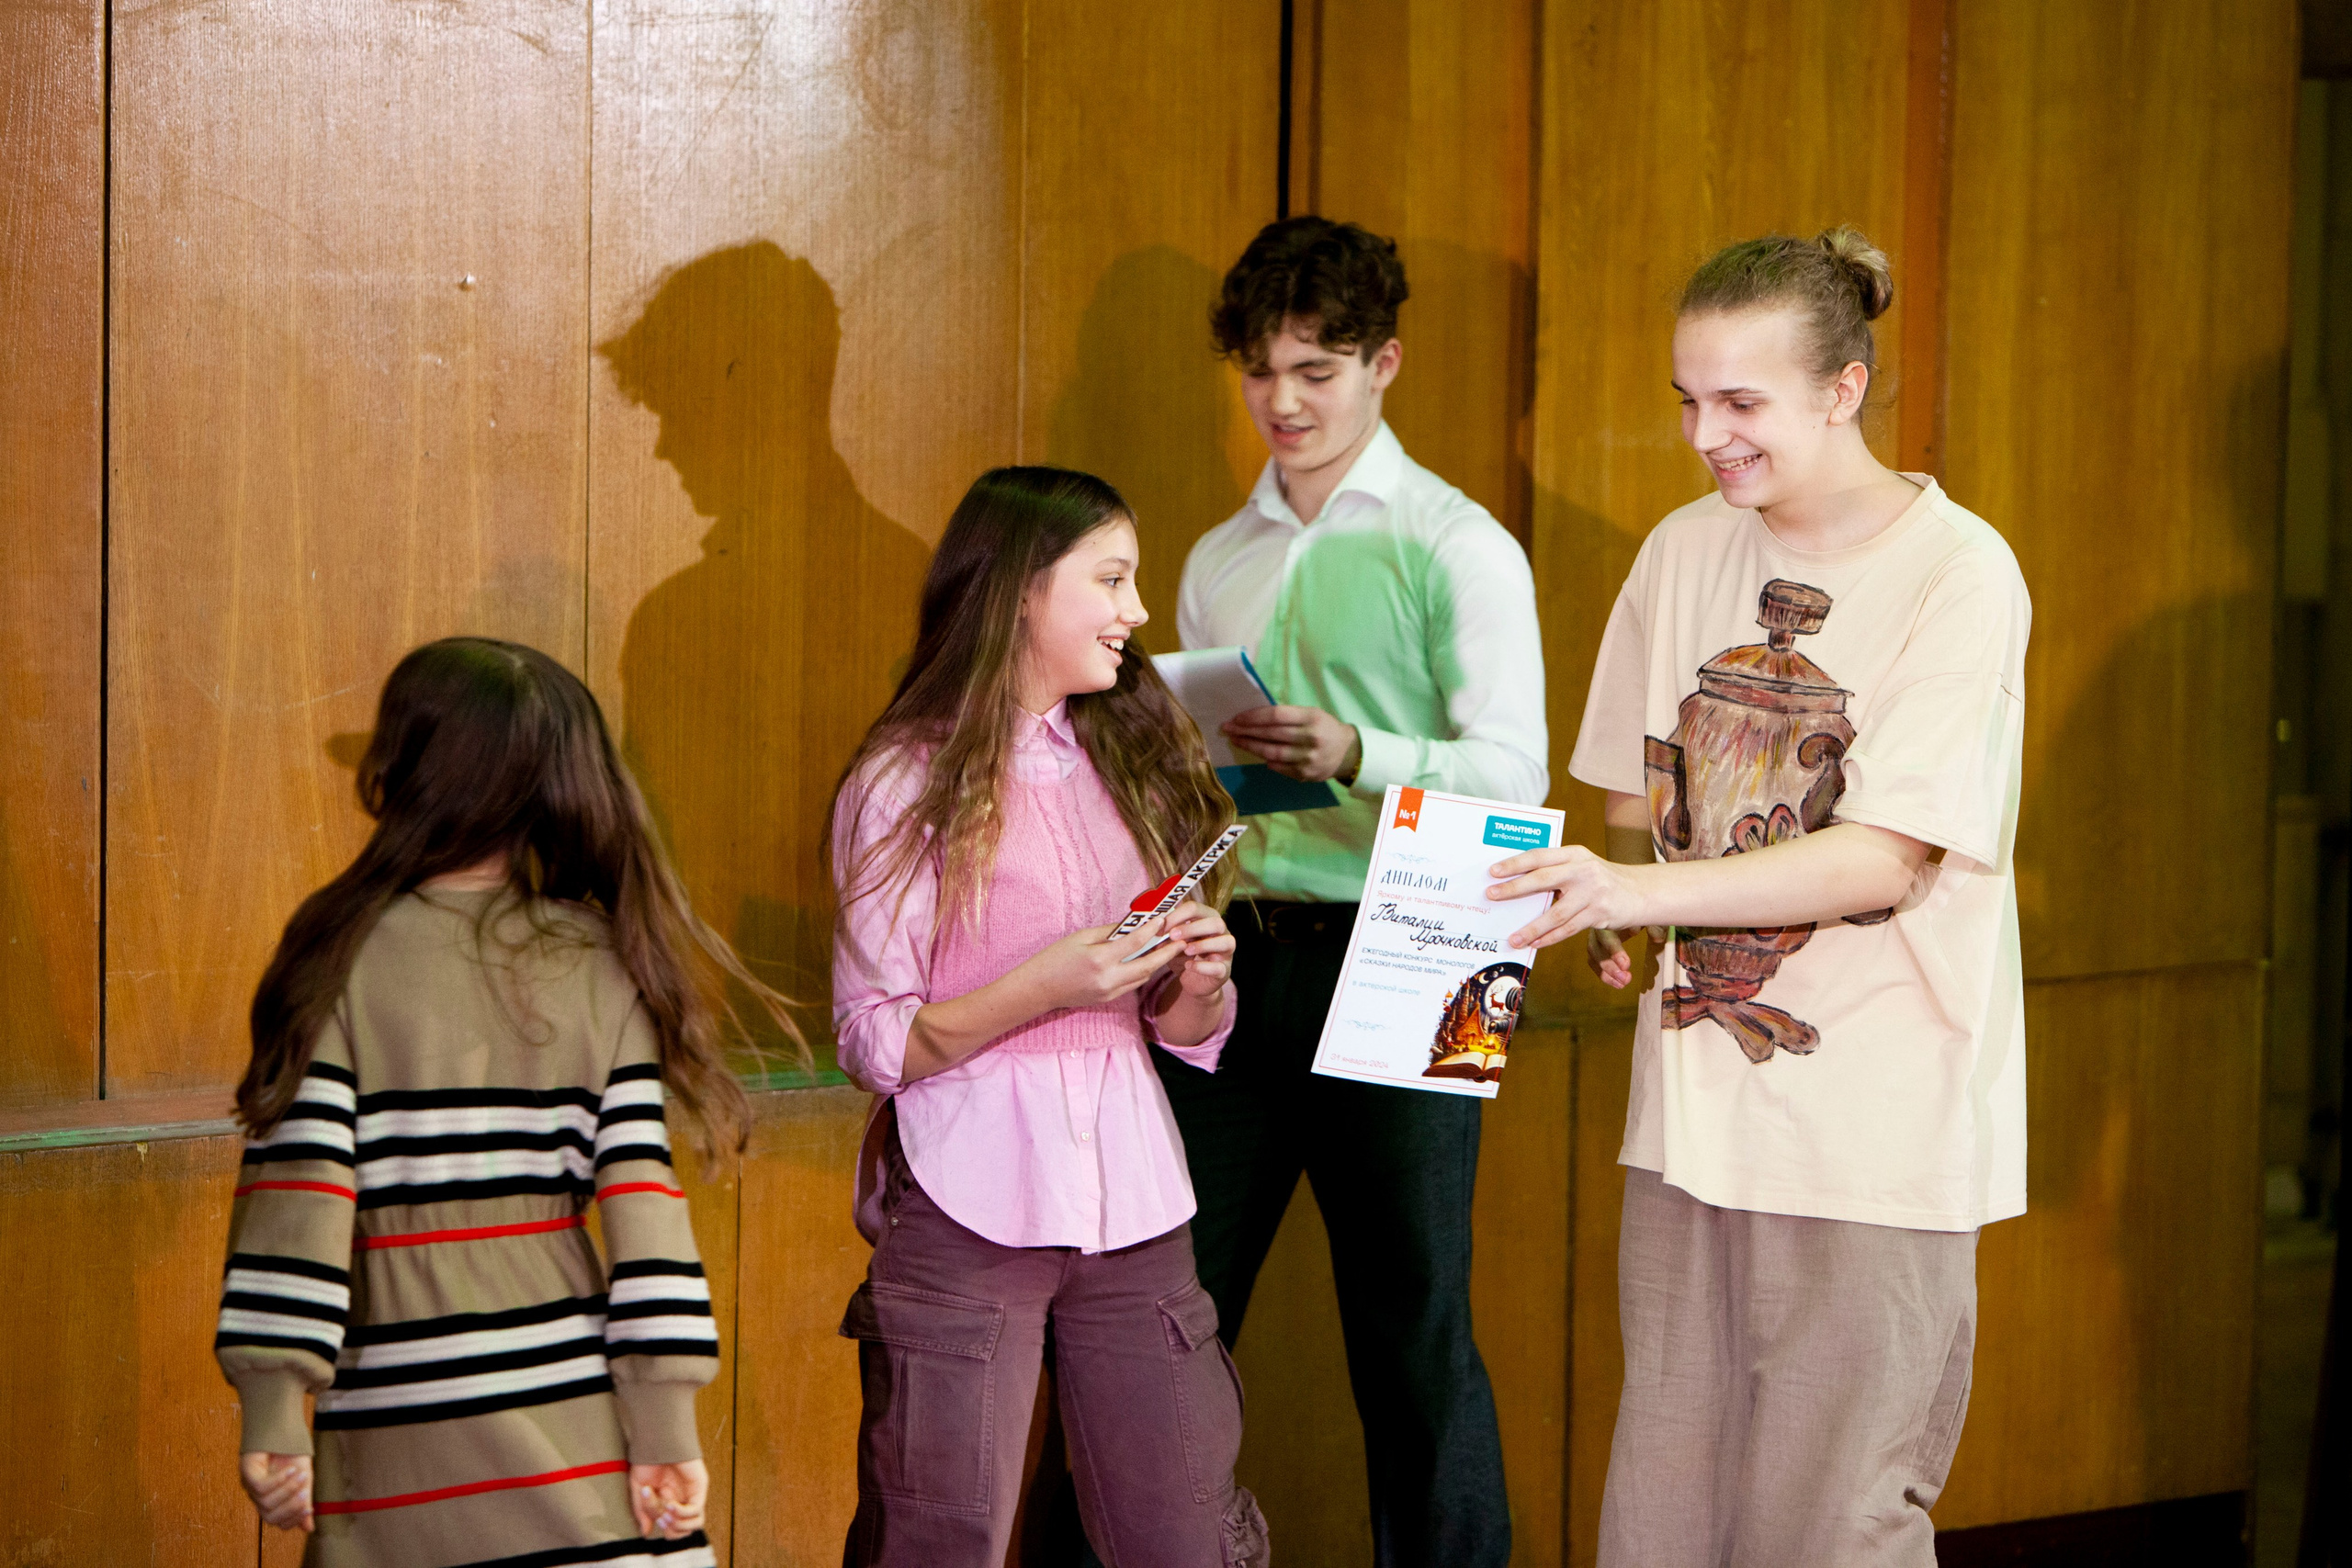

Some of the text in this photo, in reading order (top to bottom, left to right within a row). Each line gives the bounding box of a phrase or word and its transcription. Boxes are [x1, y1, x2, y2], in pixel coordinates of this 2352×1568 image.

[1398, 808, 1417, 820] №1
[1494, 822, 1542, 836] ТАЛАНТИНО
[1142, 829, 1243, 924] ЧШАЯ АКТРИСА
[1377, 890, 1405, 902] Яркому
[1414, 897, 1468, 911] талантливому
[1467, 906, 1491, 914] чтецу!
[1113, 914, 1146, 938] ТЫ
[1359, 958, 1447, 976] «СКАЗКИ НАРОДОВ МИРА»
[1362, 947, 1476, 969] ЕЖЕГОДНЫЙ КОНКУРС МОНОЛОГОВ
